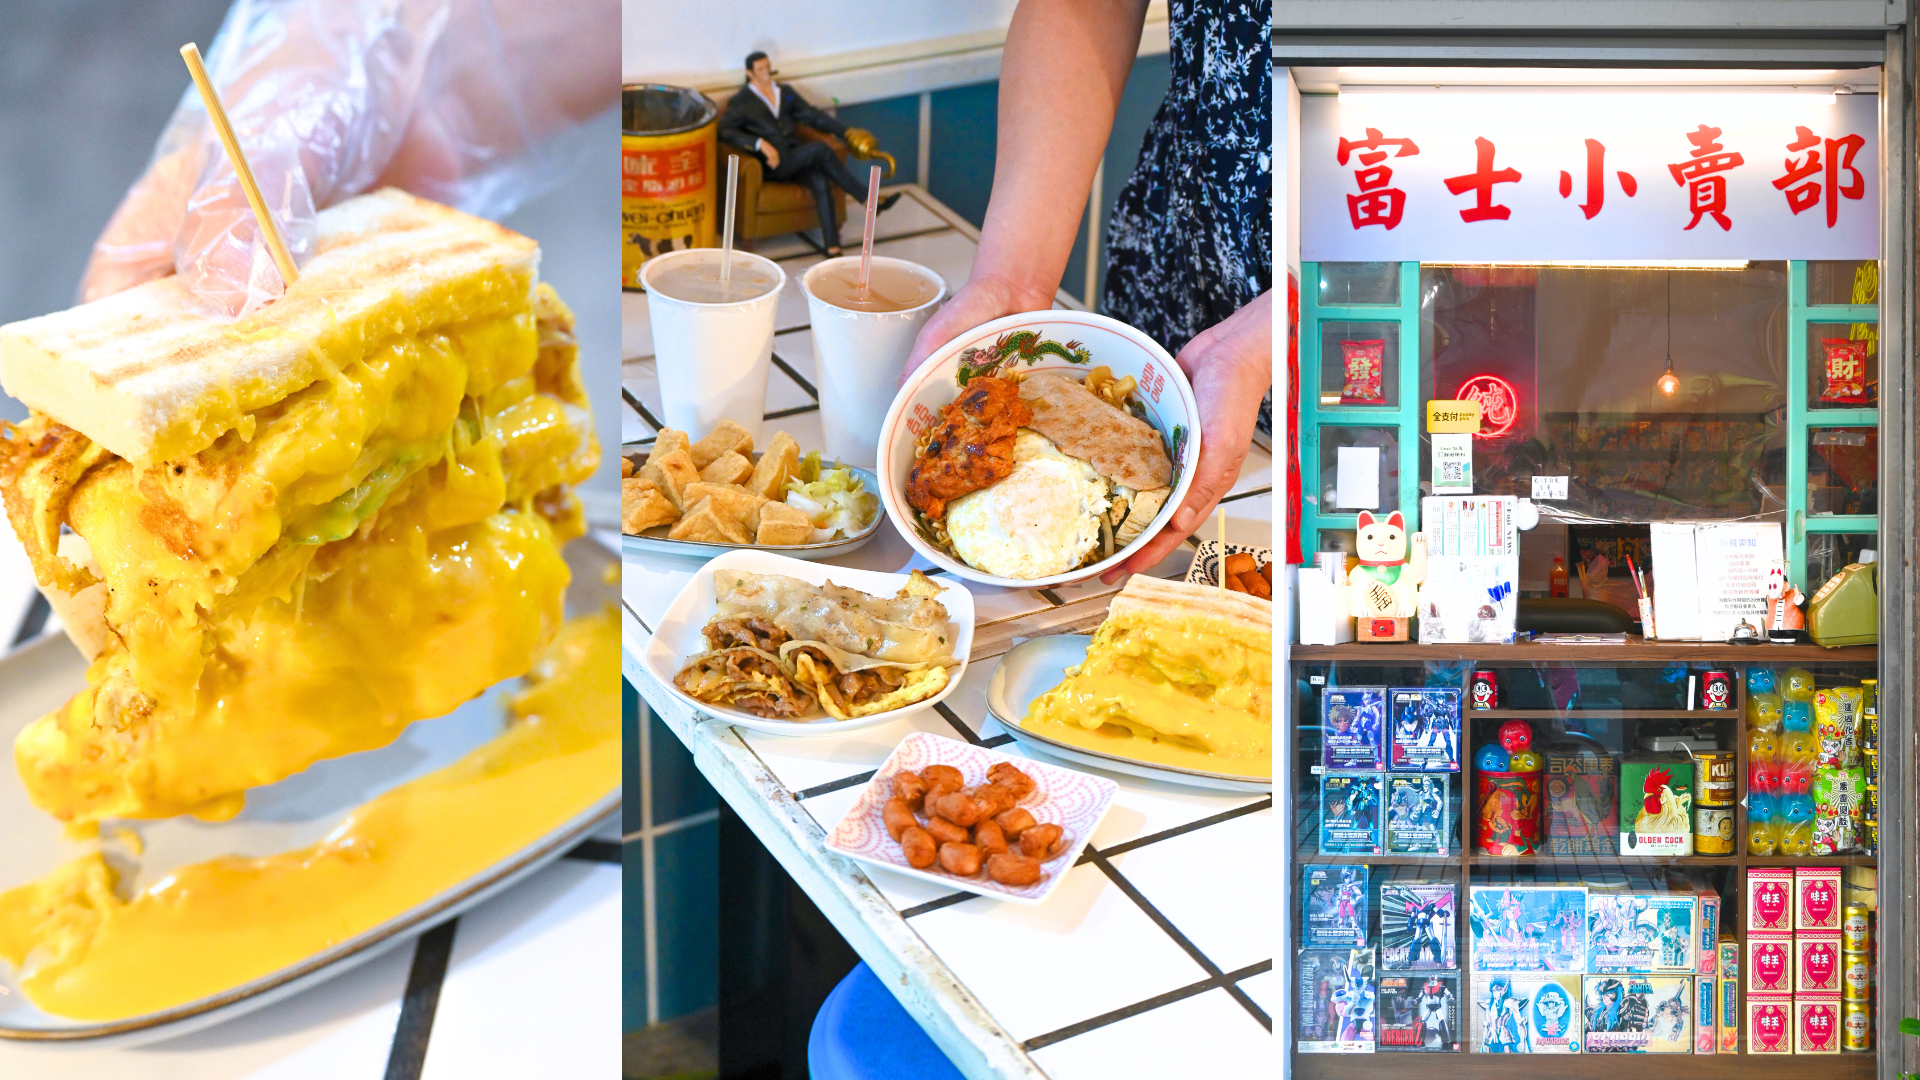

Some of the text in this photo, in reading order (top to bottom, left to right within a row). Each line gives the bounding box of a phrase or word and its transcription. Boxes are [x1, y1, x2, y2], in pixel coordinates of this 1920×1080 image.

[1337, 124, 1866, 232] 富士小賣部
[1348, 356, 1373, 380] 發
[1831, 354, 1859, 380] 財
[1432, 411, 1459, 422] 全支付
[1664, 836, 1684, 844] COCK
[1761, 892, 1780, 904] 味王
[1810, 890, 1829, 902] 味王
[1761, 953, 1779, 965] 味王
[1810, 952, 1829, 964] 味王
[1761, 1015, 1779, 1027] 味王
[1810, 1014, 1828, 1026] 味王
[1381, 1022, 1423, 1046] ENERGER Z
[1536, 1037, 1570, 1046] AQUARIUS
